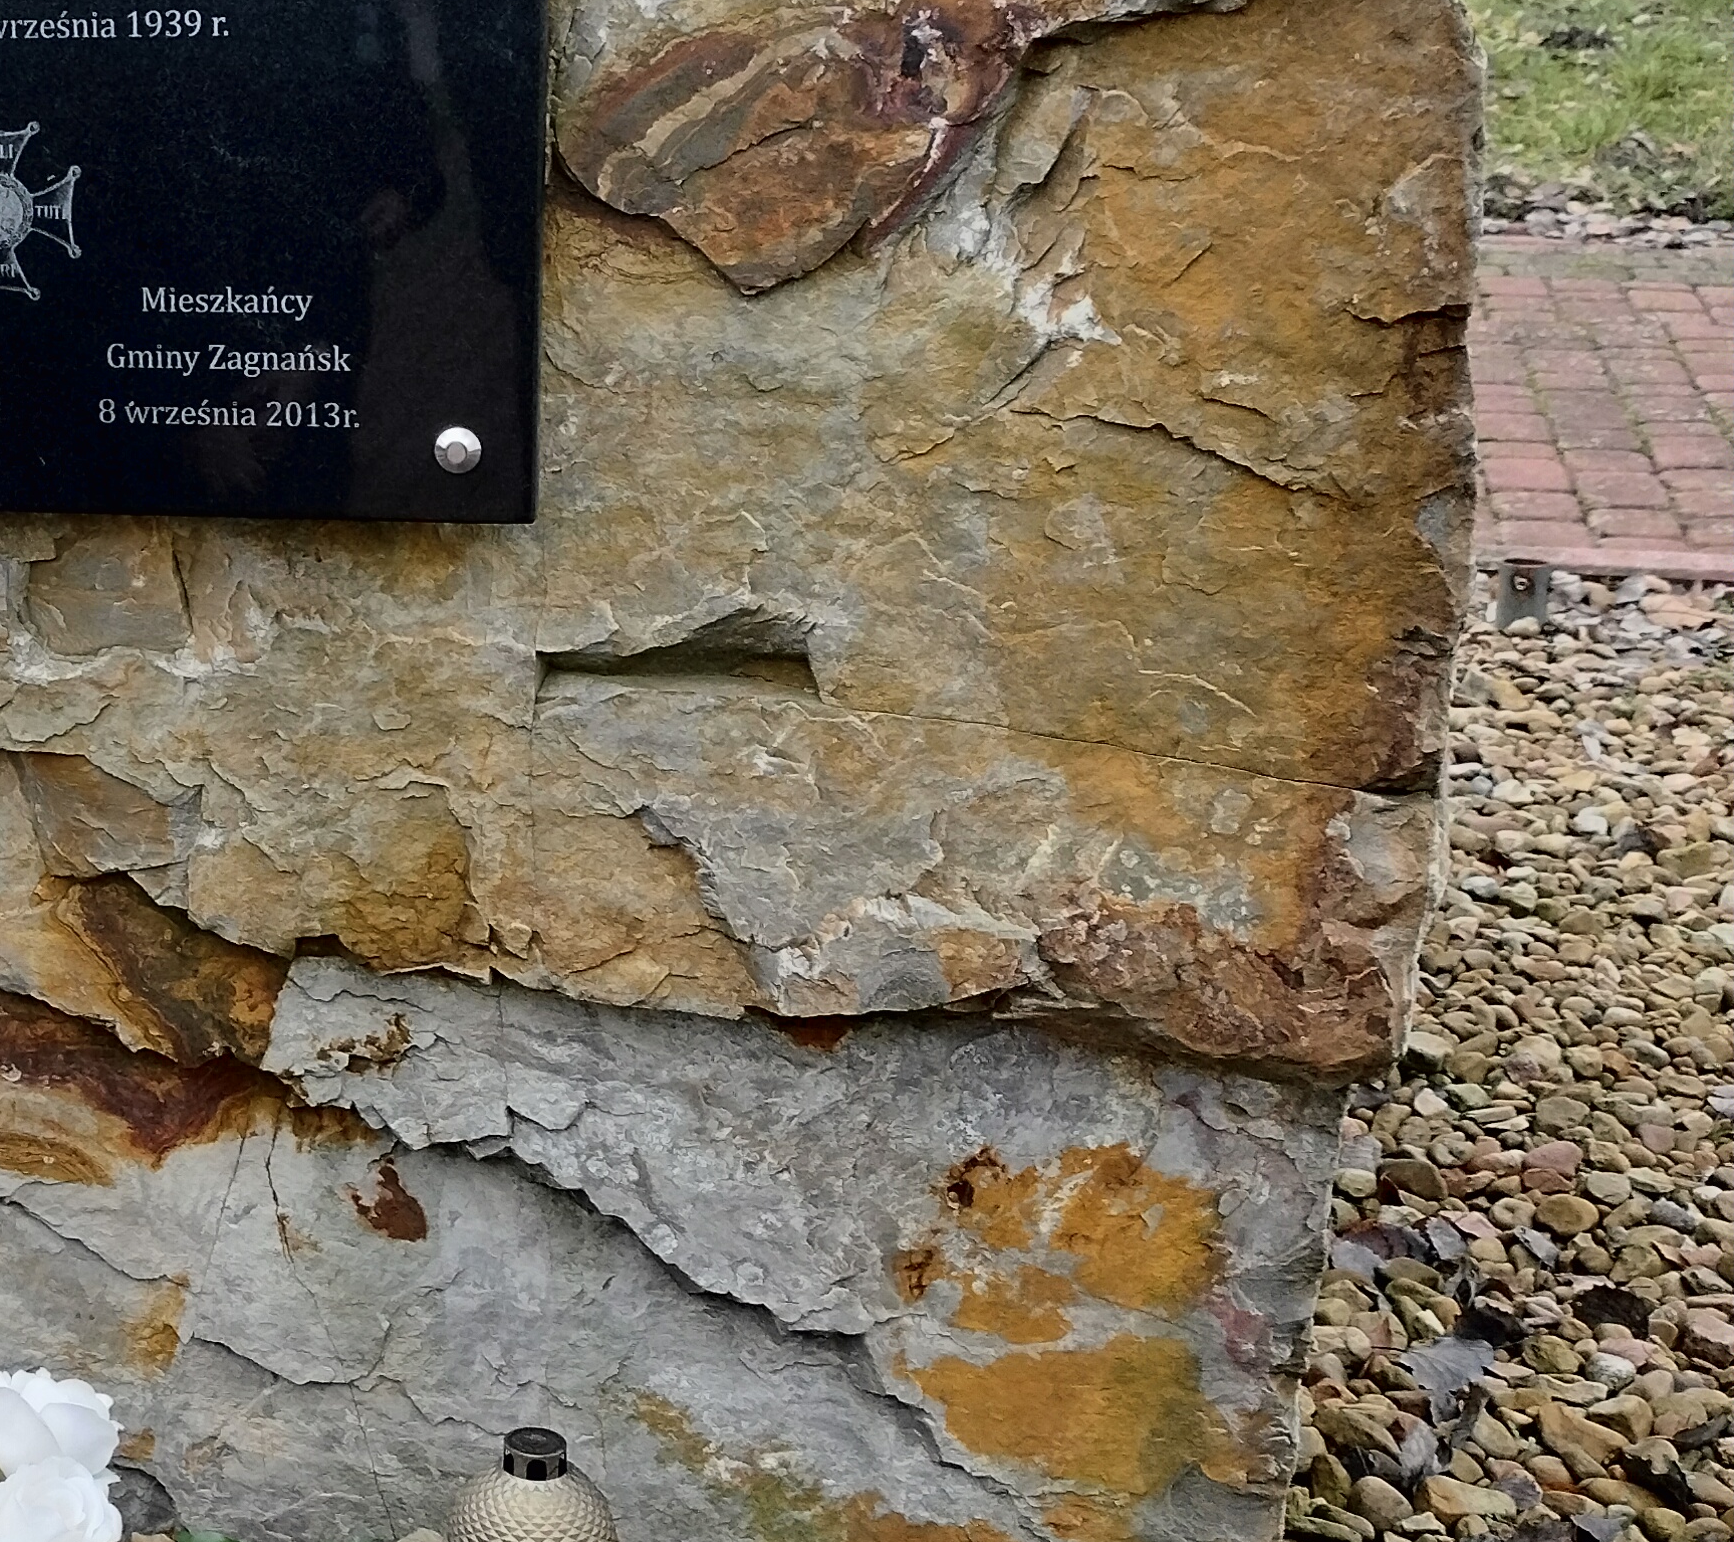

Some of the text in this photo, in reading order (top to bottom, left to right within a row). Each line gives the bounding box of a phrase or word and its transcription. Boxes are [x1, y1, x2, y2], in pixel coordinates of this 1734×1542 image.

[127, 9, 202, 38] 1939
[211, 16, 229, 37] r.
[141, 285, 313, 322] Mieszkańcy
[106, 343, 351, 378] Gminy Zagnańsk
[98, 398, 360, 428] 8 września 2013r.
